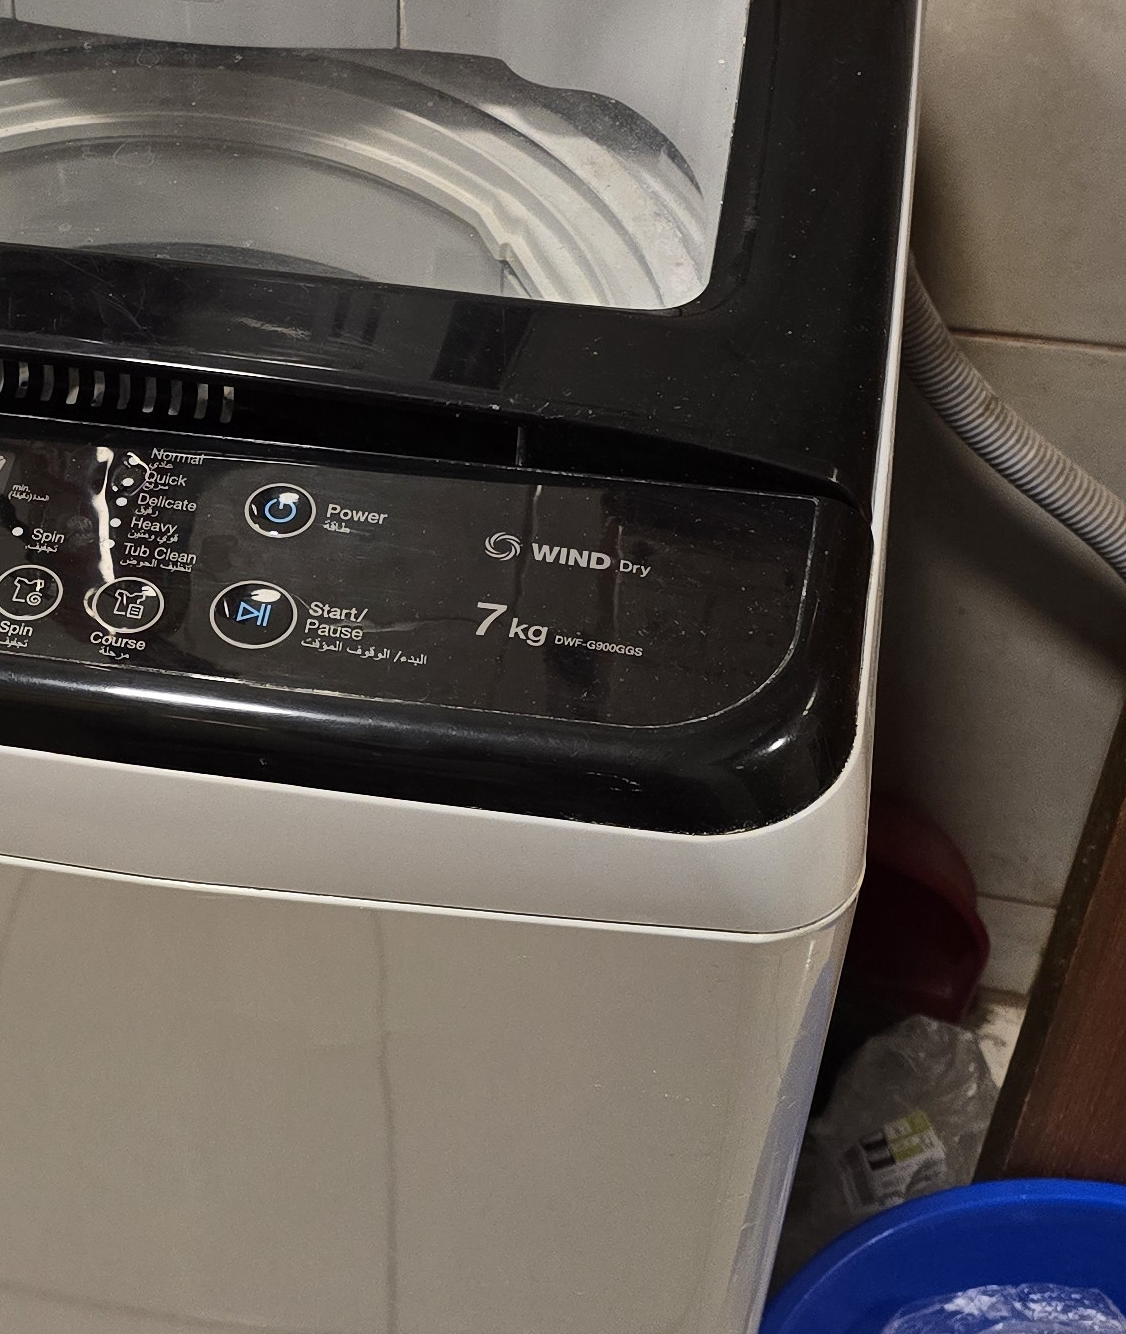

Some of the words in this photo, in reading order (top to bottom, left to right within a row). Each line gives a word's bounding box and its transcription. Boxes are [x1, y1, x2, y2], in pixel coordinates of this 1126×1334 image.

[151, 448, 204, 465] Normal
[12, 484, 30, 492] min.
[146, 470, 187, 487] Quick
[137, 492, 197, 512] Delicate
[326, 504, 388, 525] Power
[32, 528, 65, 543] Spin
[131, 516, 178, 536] Heavy
[124, 542, 150, 557] Tub
[154, 547, 197, 564] Clean
[532, 542, 612, 570] WIND
[619, 559, 652, 578] Dry
[309, 602, 368, 622] Start/
[304, 619, 364, 641] Pause
[90, 631, 146, 650] Course
[554, 635, 644, 657] DWF-G900GGS
